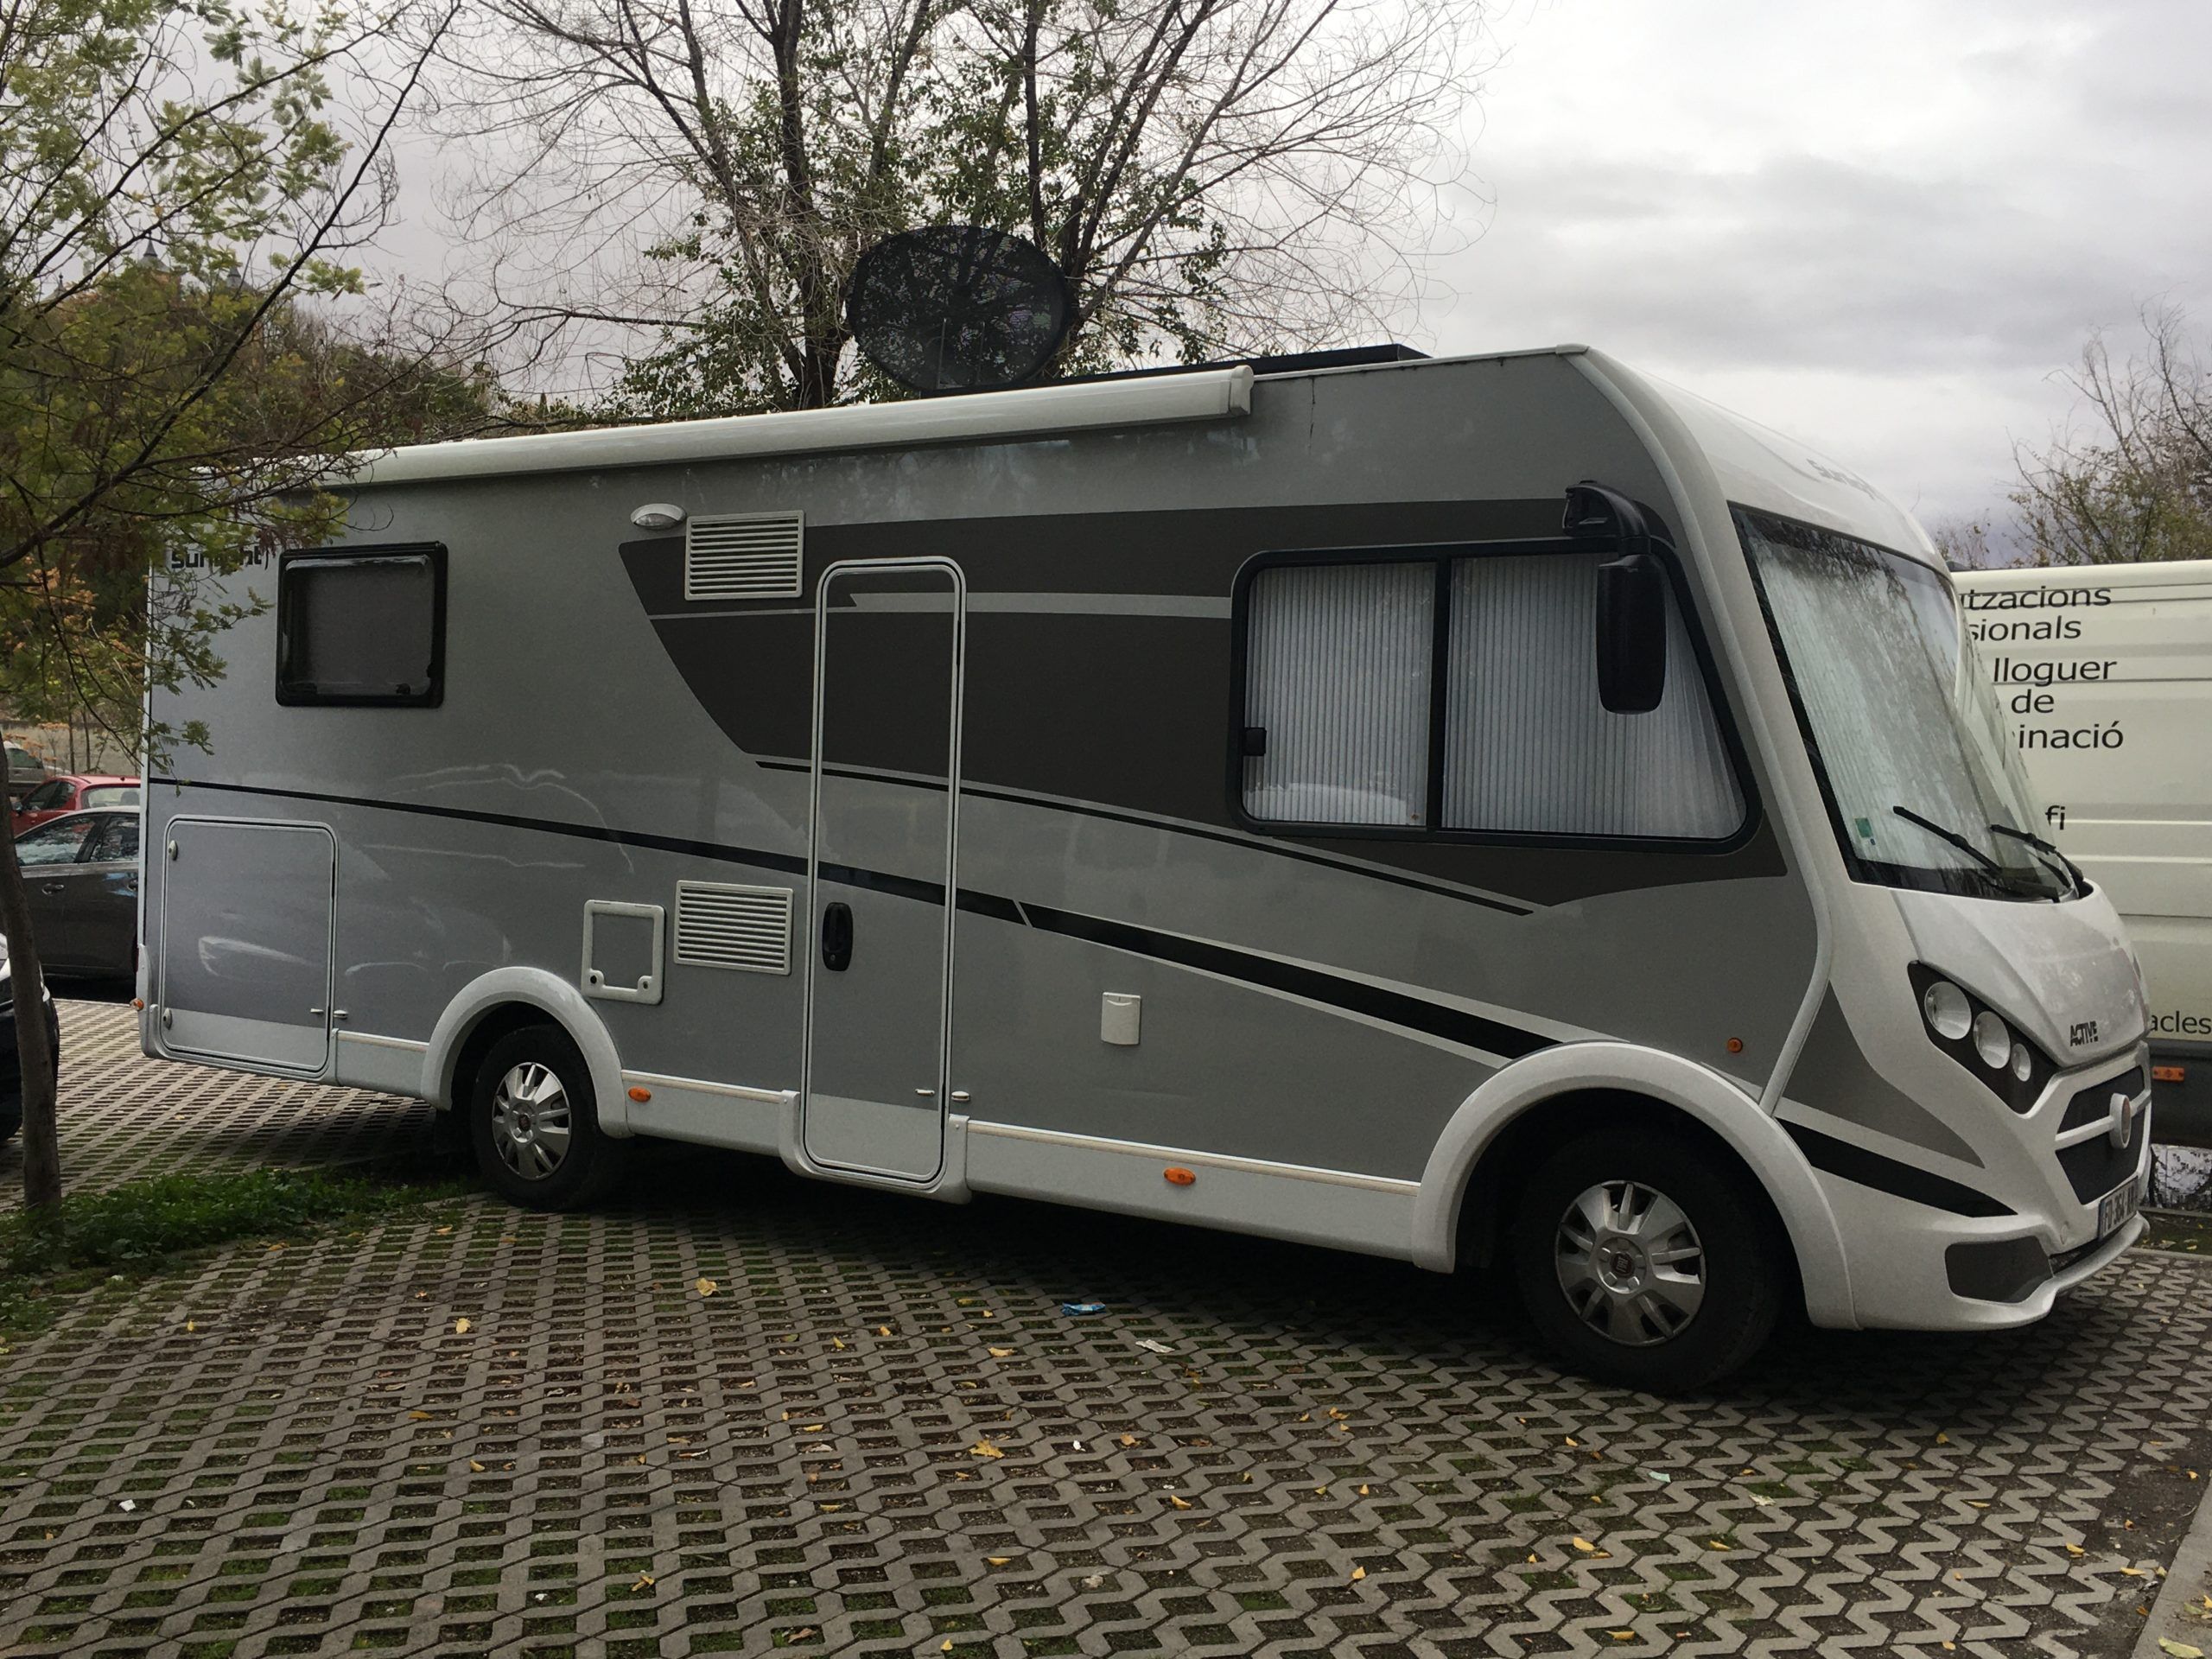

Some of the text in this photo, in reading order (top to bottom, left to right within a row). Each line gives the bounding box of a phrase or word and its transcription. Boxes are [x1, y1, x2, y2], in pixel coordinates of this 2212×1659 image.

[1993, 658, 2118, 688] lloguer
[2011, 689, 2056, 715] de
[2018, 721, 2125, 749] inació
[2045, 804, 2066, 830] fi
[2069, 1020, 2099, 1046] ACTIVE
